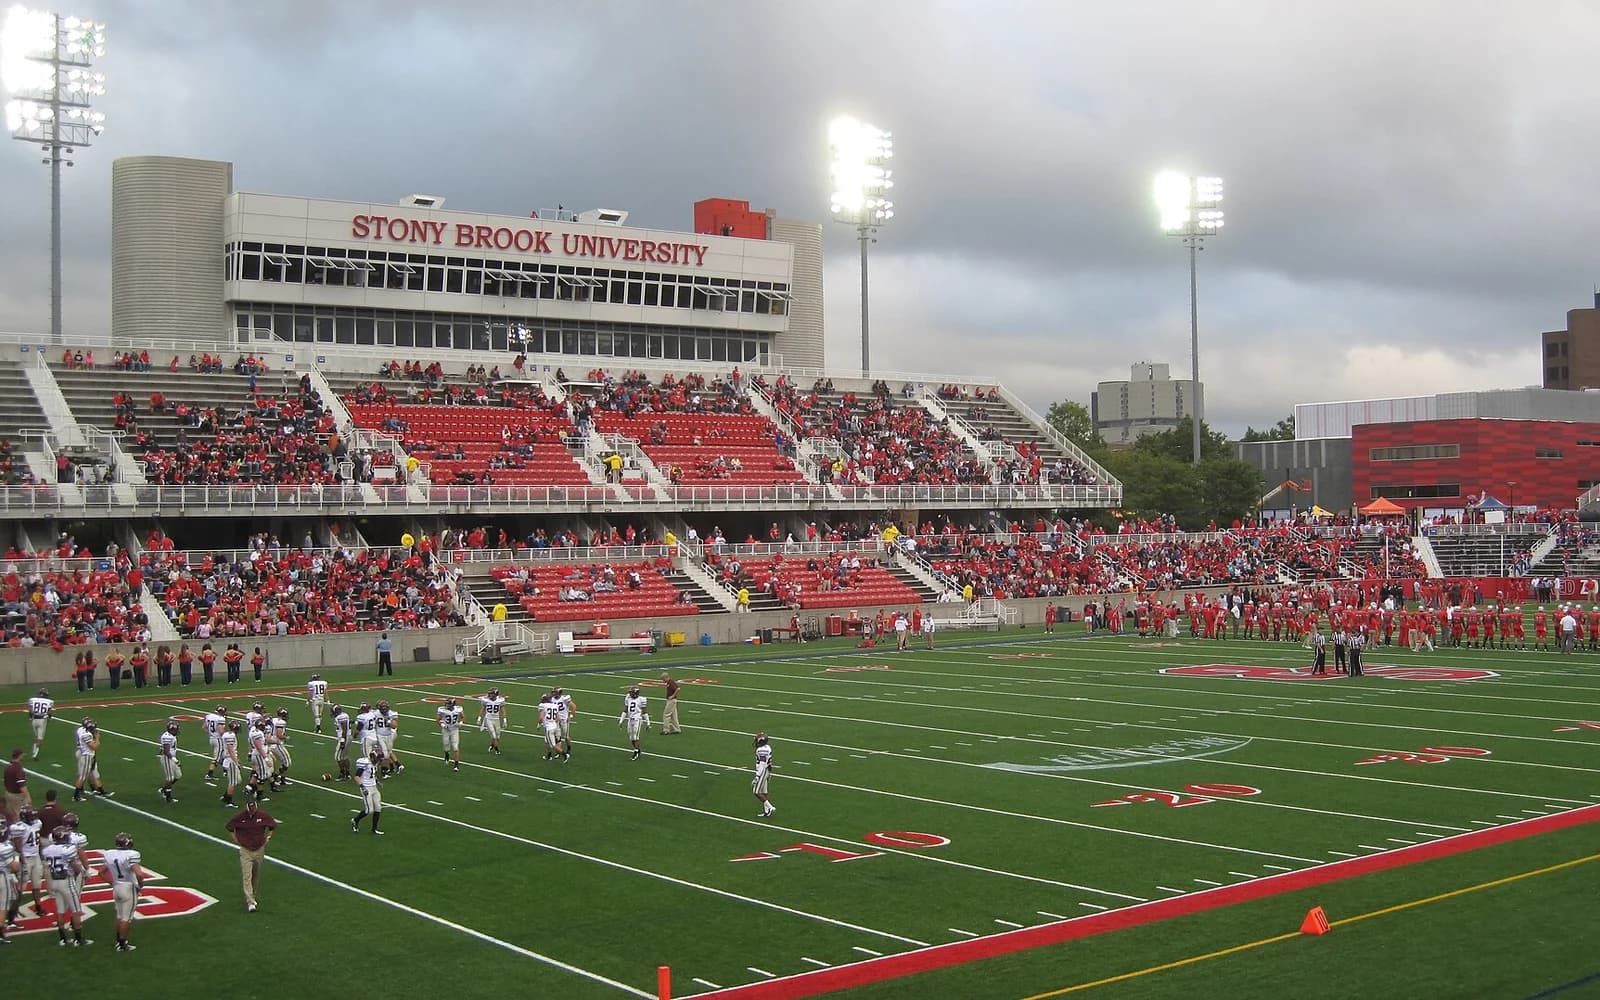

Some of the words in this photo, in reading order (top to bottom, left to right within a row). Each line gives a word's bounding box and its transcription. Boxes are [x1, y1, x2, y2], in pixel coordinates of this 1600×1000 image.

[352, 214, 447, 245] STONY
[455, 223, 552, 253] BROOK
[562, 233, 709, 267] UNIVERSITY
[314, 684, 325, 695] 18
[33, 702, 47, 714] 86
[486, 704, 499, 714] 29
[629, 702, 637, 712] 2
[1373, 746, 1492, 764] 30
[1121, 783, 1262, 808] 20
[777, 830, 951, 863] 10
[115, 859, 124, 879] 1
